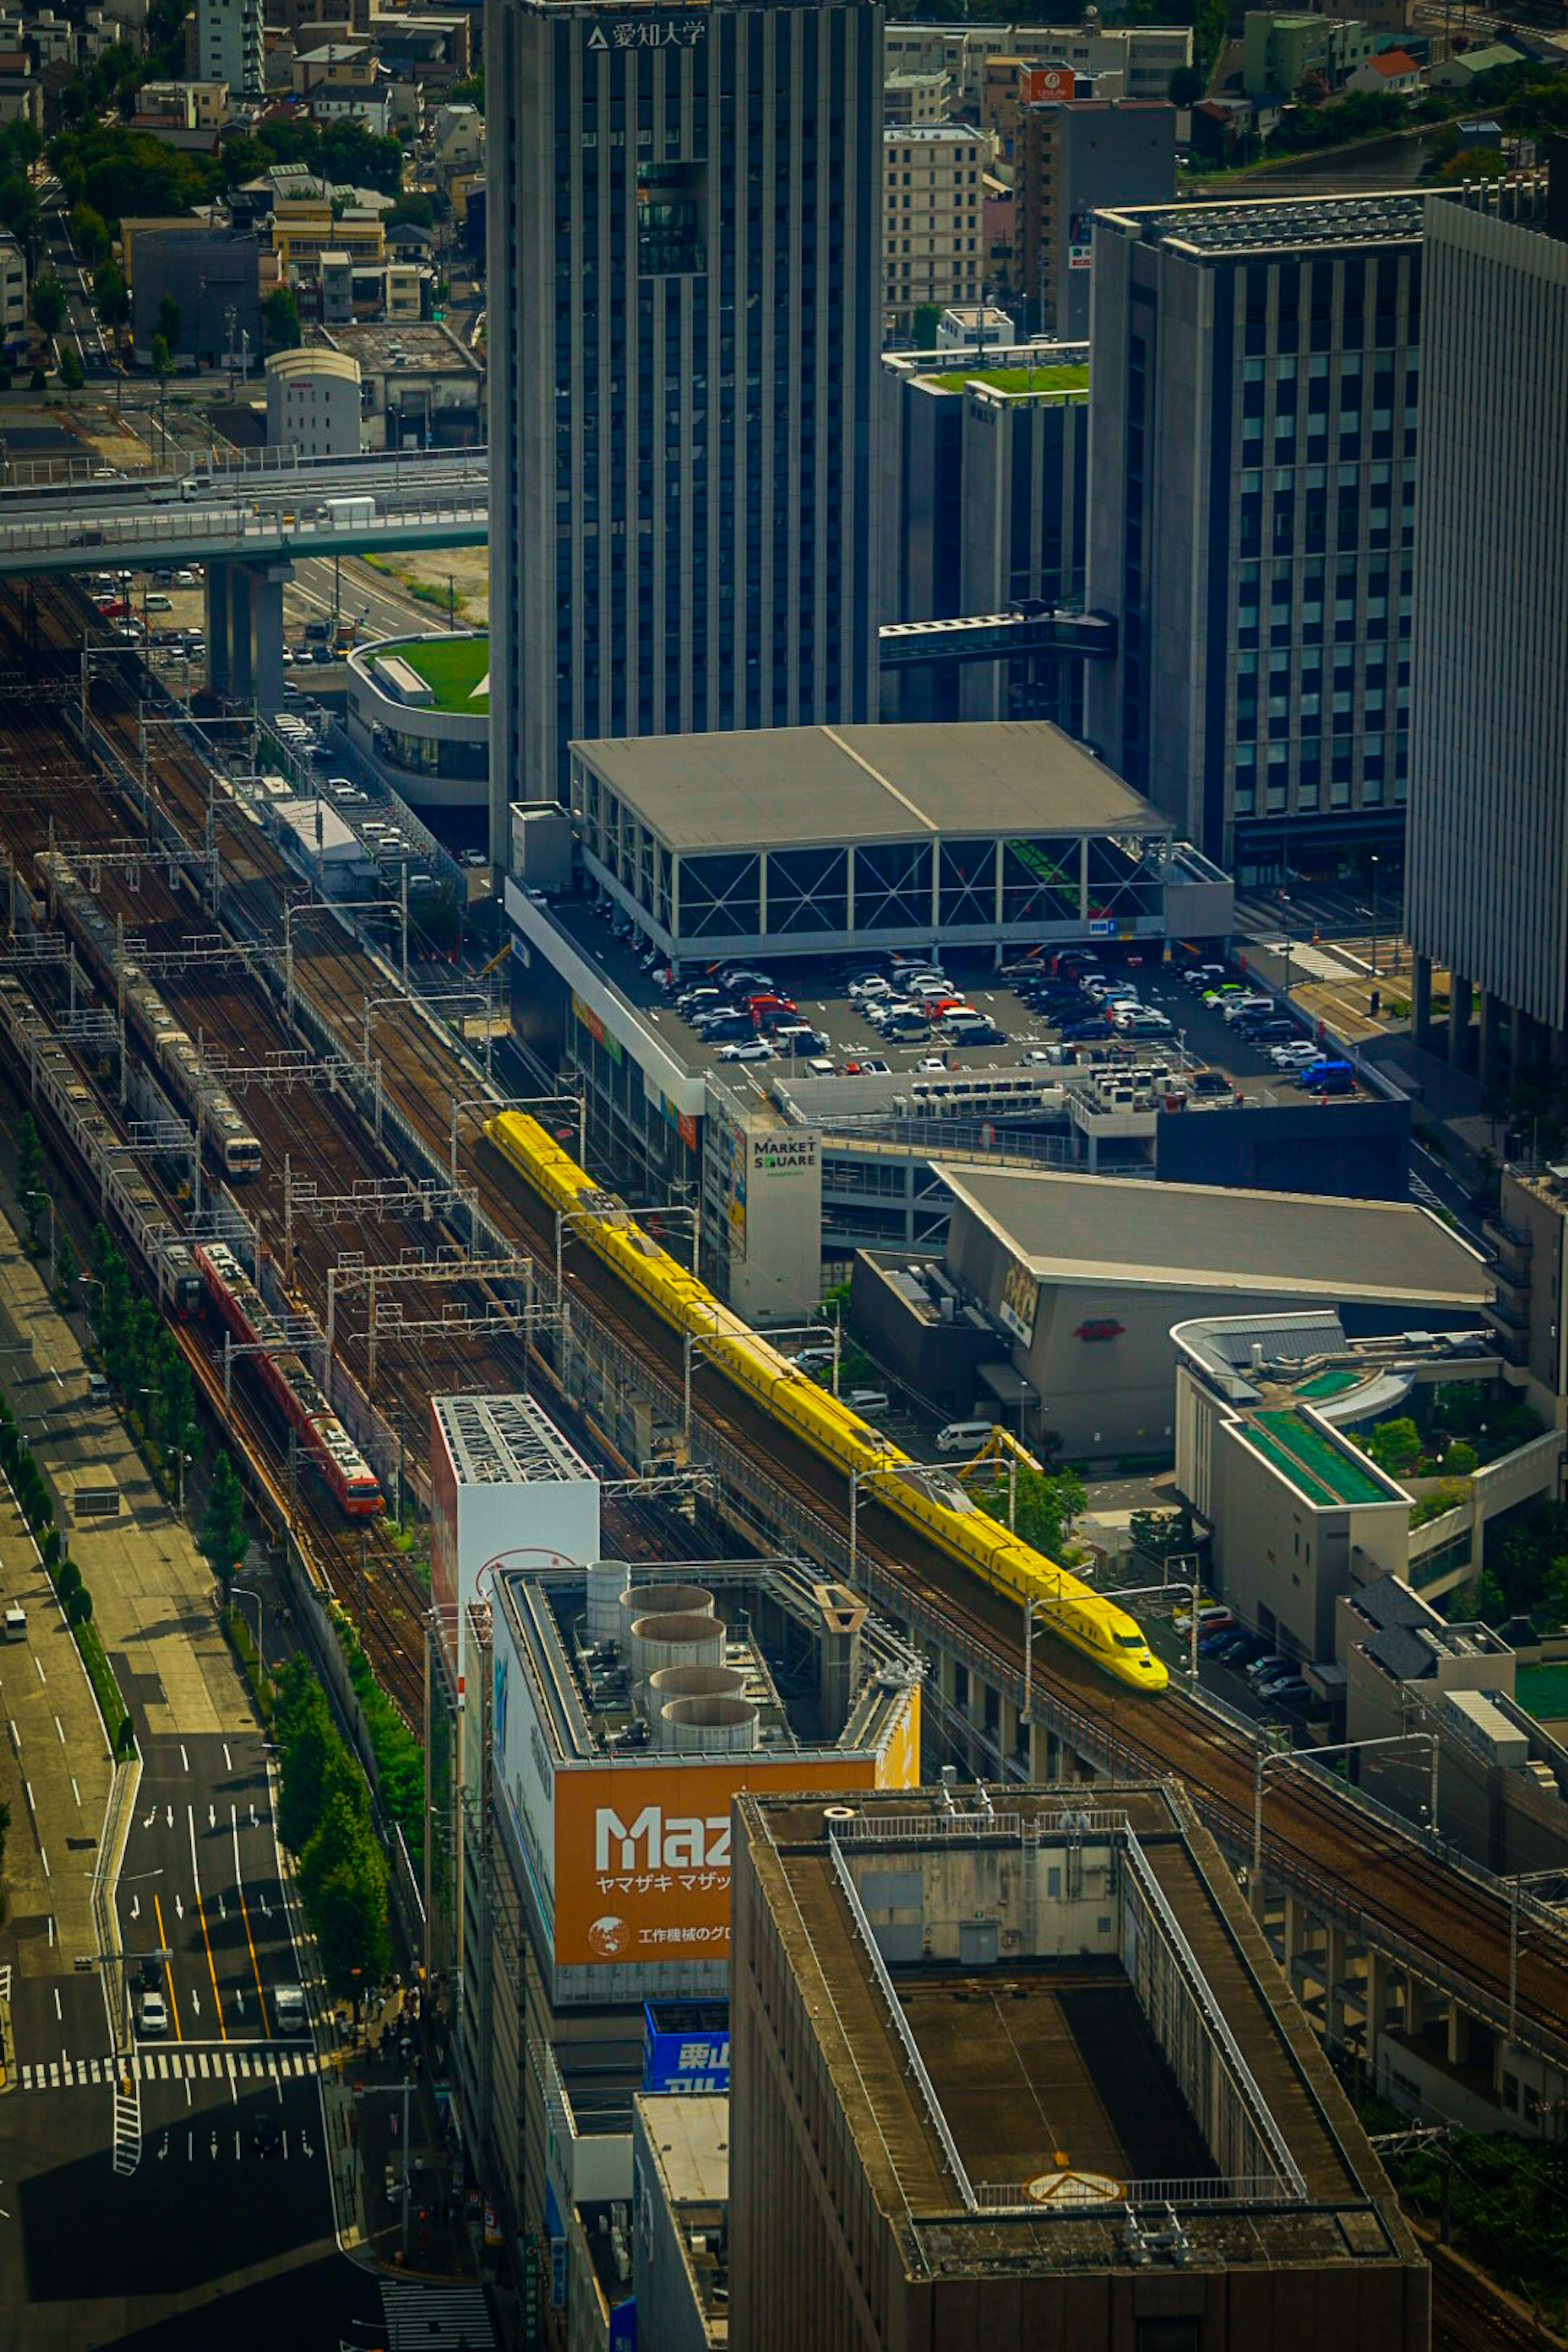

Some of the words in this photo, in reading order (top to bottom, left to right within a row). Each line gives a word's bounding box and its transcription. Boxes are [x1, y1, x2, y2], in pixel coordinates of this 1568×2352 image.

[613, 20, 706, 48] 愛知大学
[755, 1142, 816, 1154] MARKET
[755, 1156, 815, 1167] SQUARE
[596, 1873, 673, 1894] ヤマザキ
